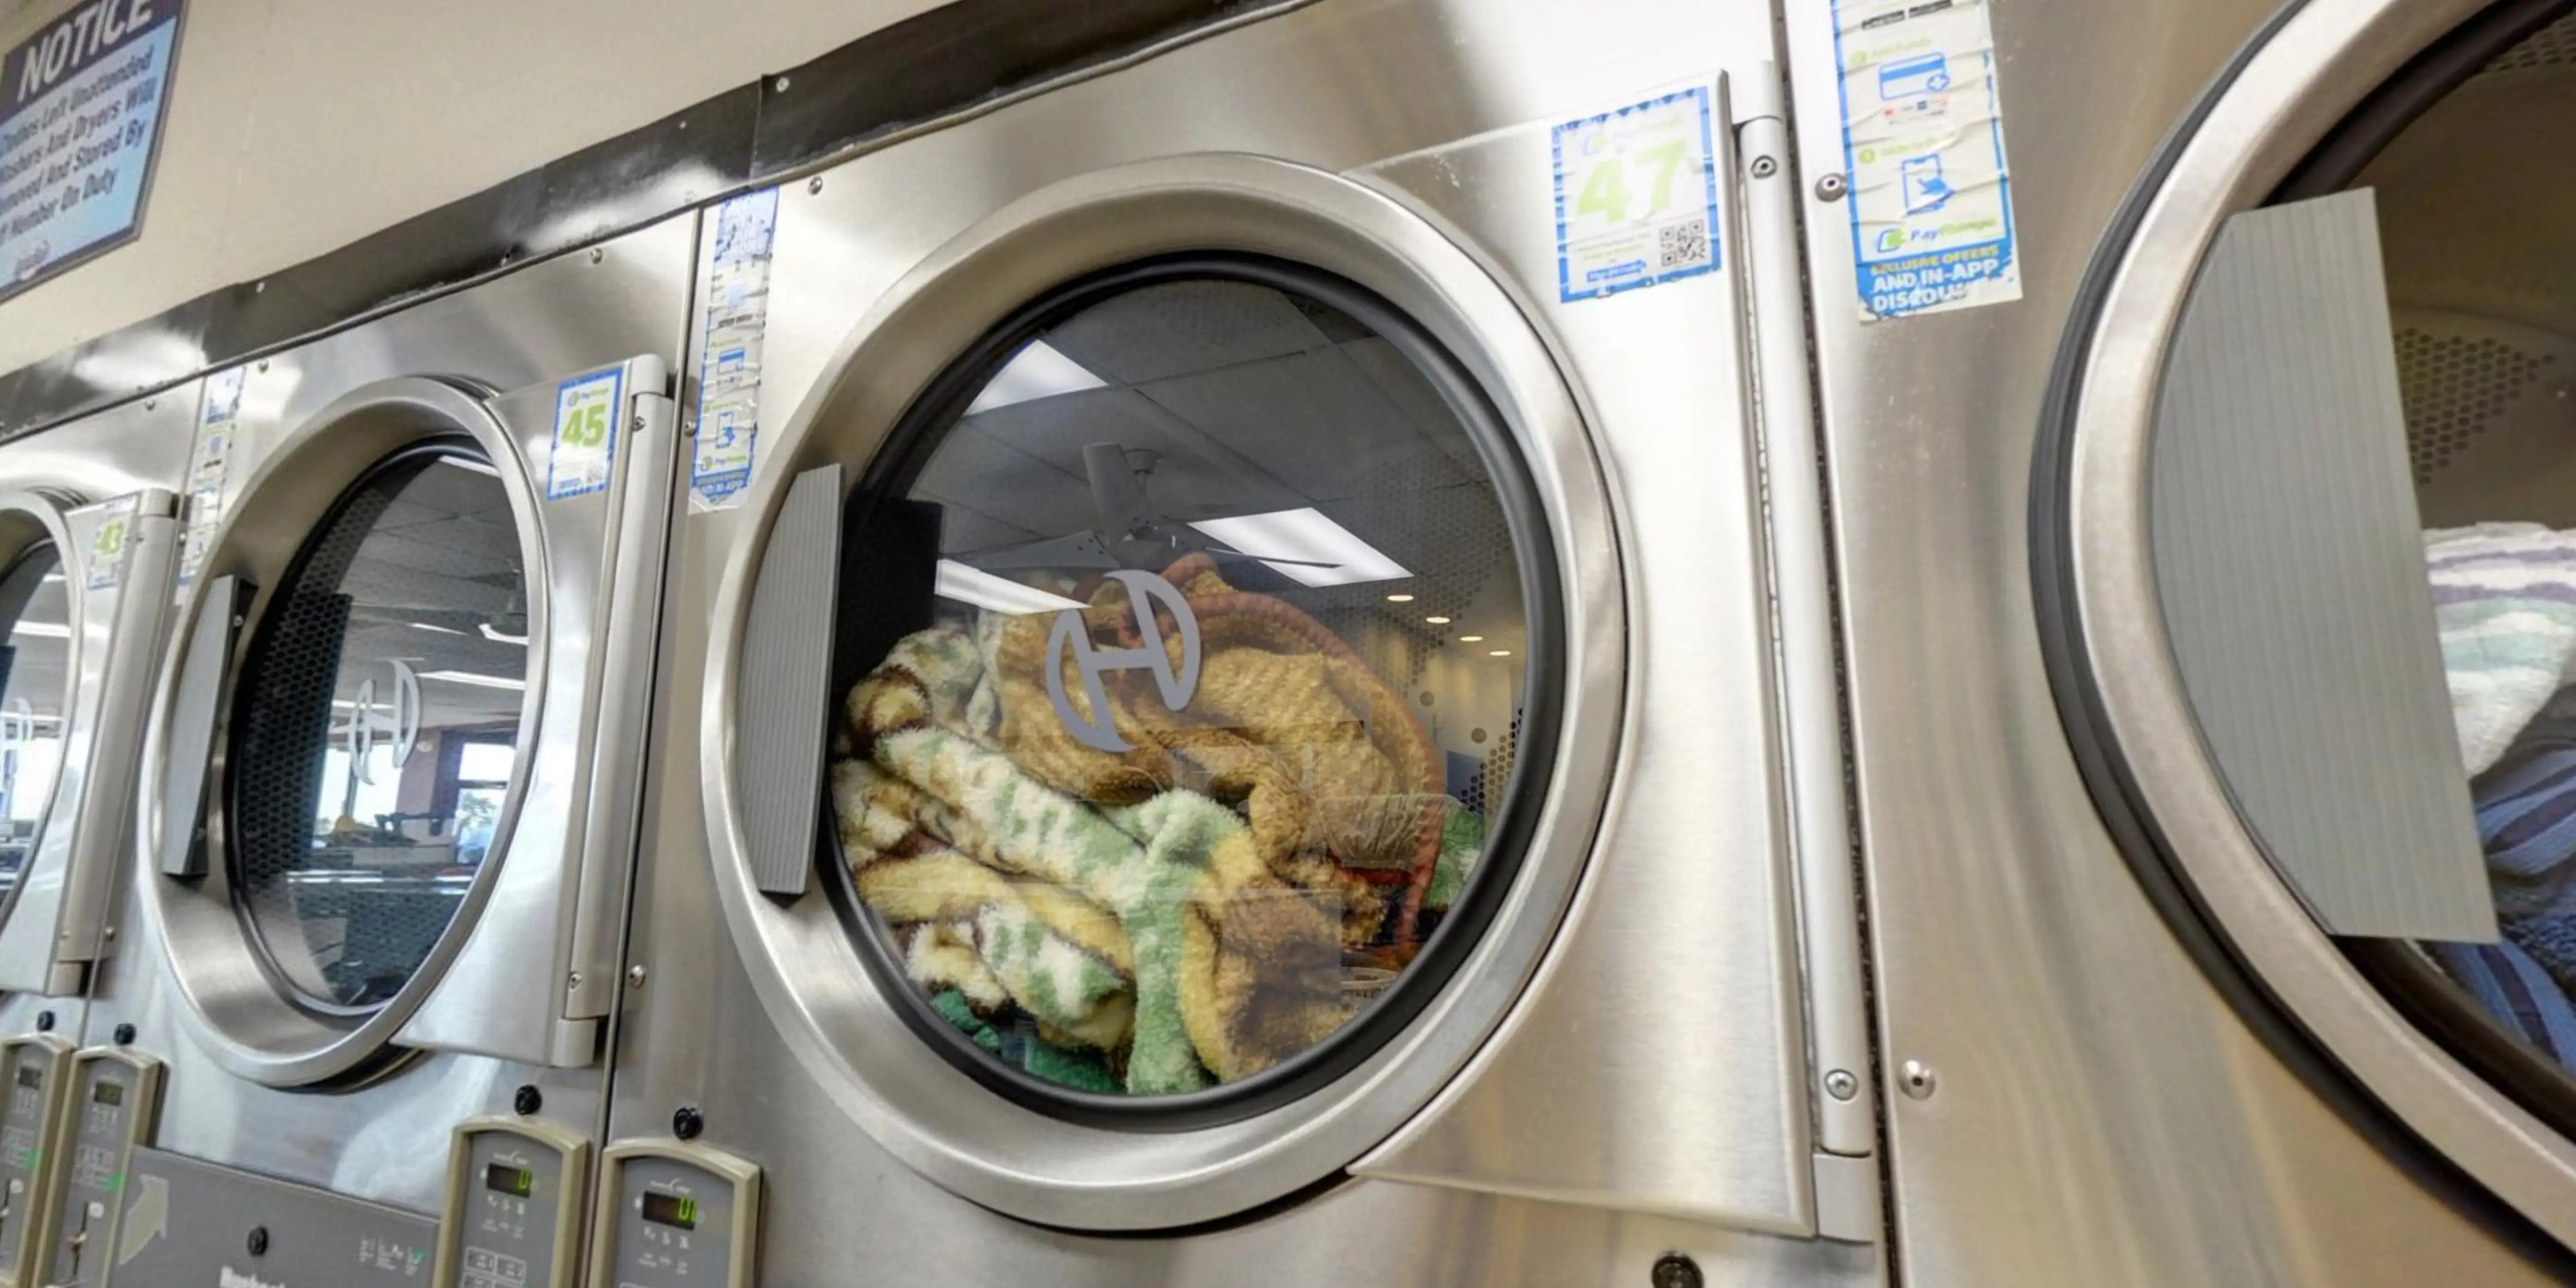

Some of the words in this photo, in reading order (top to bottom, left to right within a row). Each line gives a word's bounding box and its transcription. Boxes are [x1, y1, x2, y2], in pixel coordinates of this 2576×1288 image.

[18, 0, 153, 102] NOTICE
[1576, 140, 1689, 224] 47
[1870, 273, 1916, 294] AND
[1920, 258, 1999, 285] IN-APP
[1871, 255, 1939, 275] EXCLUSIVE
[561, 404, 607, 447] 45
